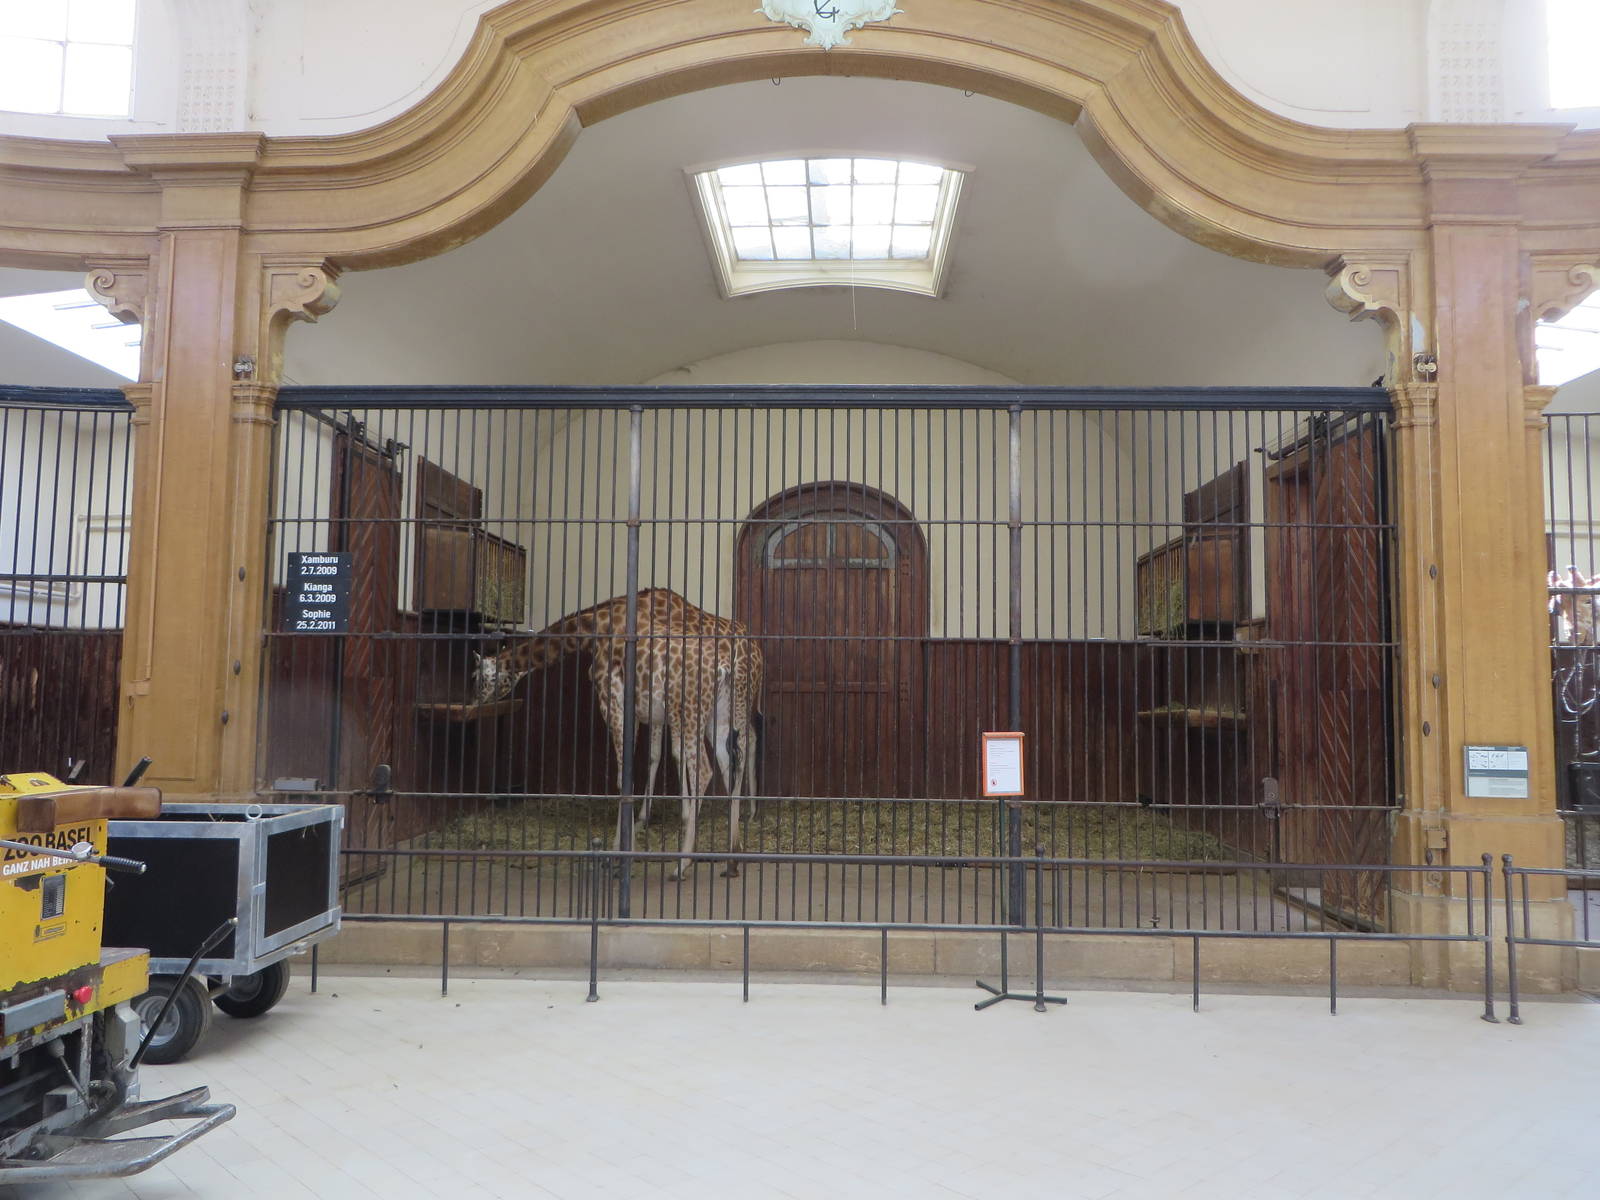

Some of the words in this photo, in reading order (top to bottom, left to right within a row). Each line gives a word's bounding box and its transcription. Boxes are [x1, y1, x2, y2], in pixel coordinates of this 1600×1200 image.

[301, 555, 339, 564] Xamburu
[301, 566, 337, 575] 2.7.2009
[303, 582, 333, 593] Kianga
[299, 594, 337, 603] 6.3.2009
[302, 609, 331, 620] Sophie
[296, 620, 336, 630] 25.2.2011
[4, 834, 41, 861] ZOO
[45, 827, 94, 851] BASEL
[3, 861, 29, 875] GANZ
[31, 857, 50, 870] NAH
